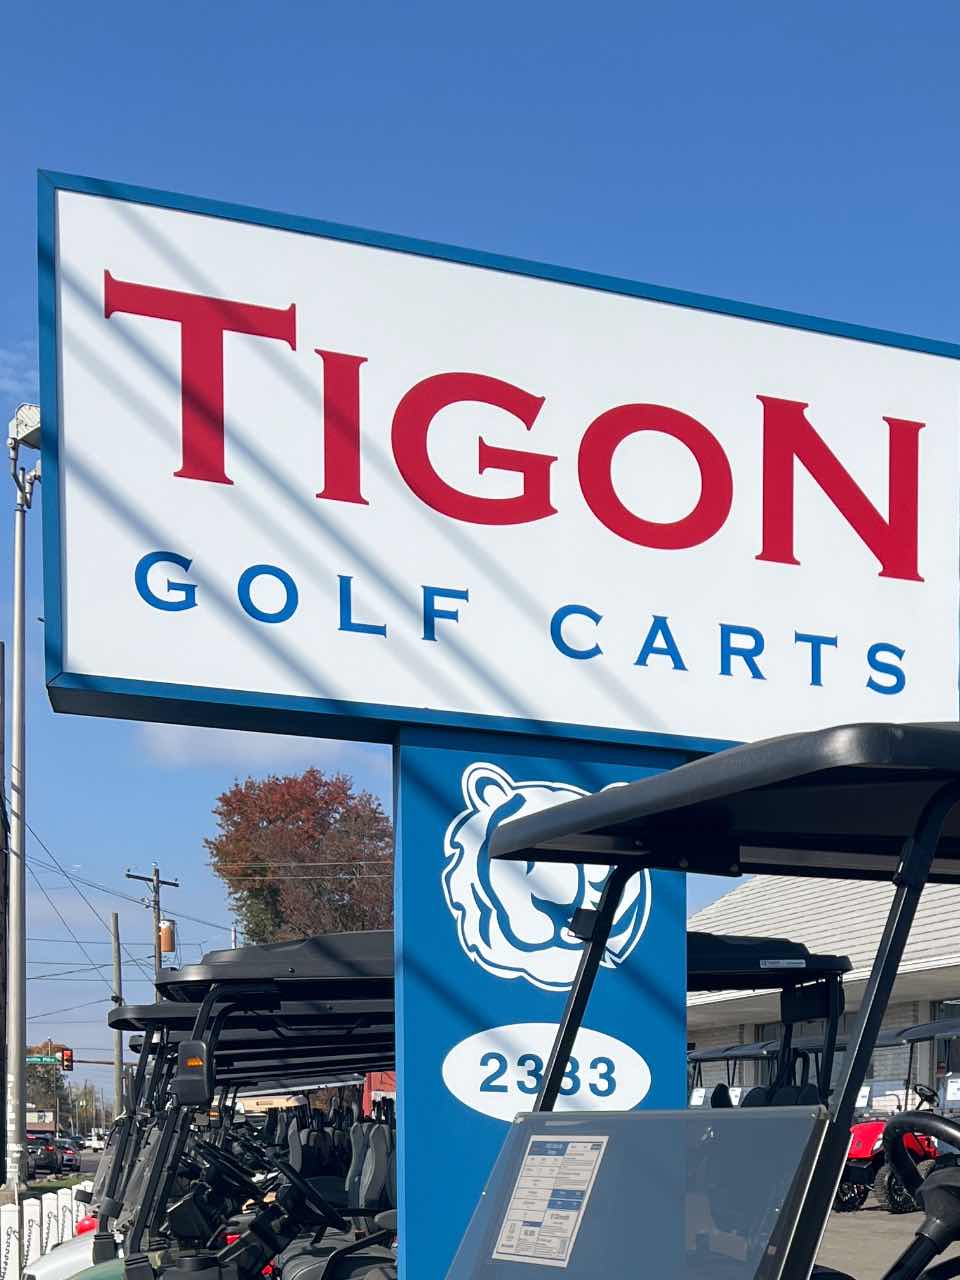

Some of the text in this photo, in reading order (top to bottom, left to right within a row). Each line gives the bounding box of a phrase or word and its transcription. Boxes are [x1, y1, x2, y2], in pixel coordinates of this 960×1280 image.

[104, 269, 926, 582] TIGON
[134, 550, 907, 696] GOLF CARTS
